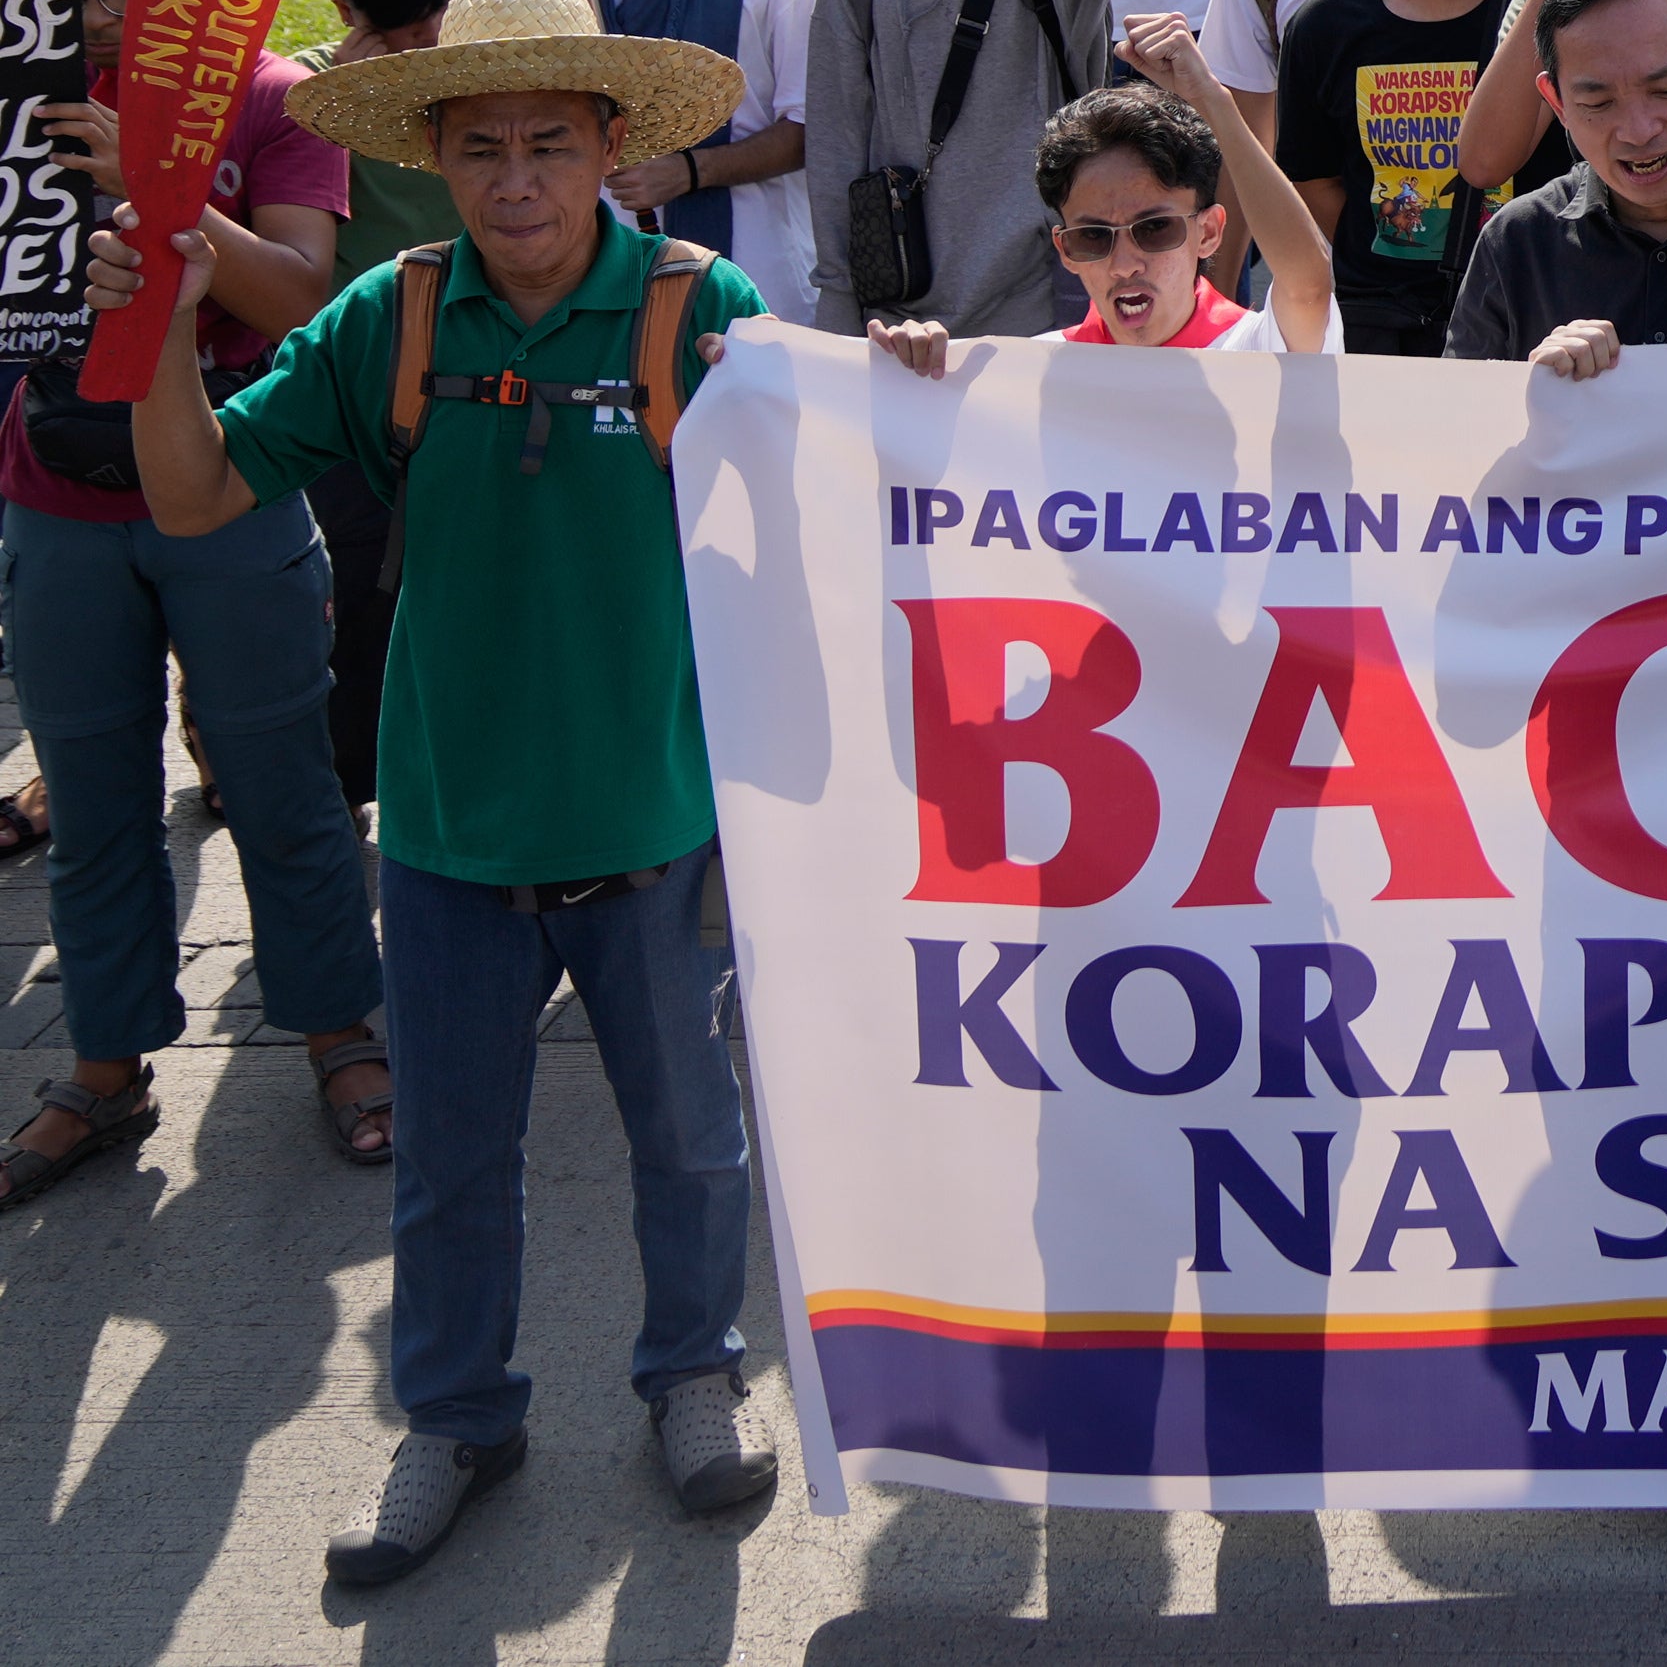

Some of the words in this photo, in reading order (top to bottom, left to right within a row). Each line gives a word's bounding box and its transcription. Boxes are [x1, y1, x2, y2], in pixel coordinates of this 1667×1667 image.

[1374, 69, 1455, 90] WAKASAN
[0, 222, 81, 295] E!
[888, 485, 1401, 556] IPAGLABAN
[1420, 492, 1602, 556] ANG
[1181, 1124, 1517, 1277] NA
